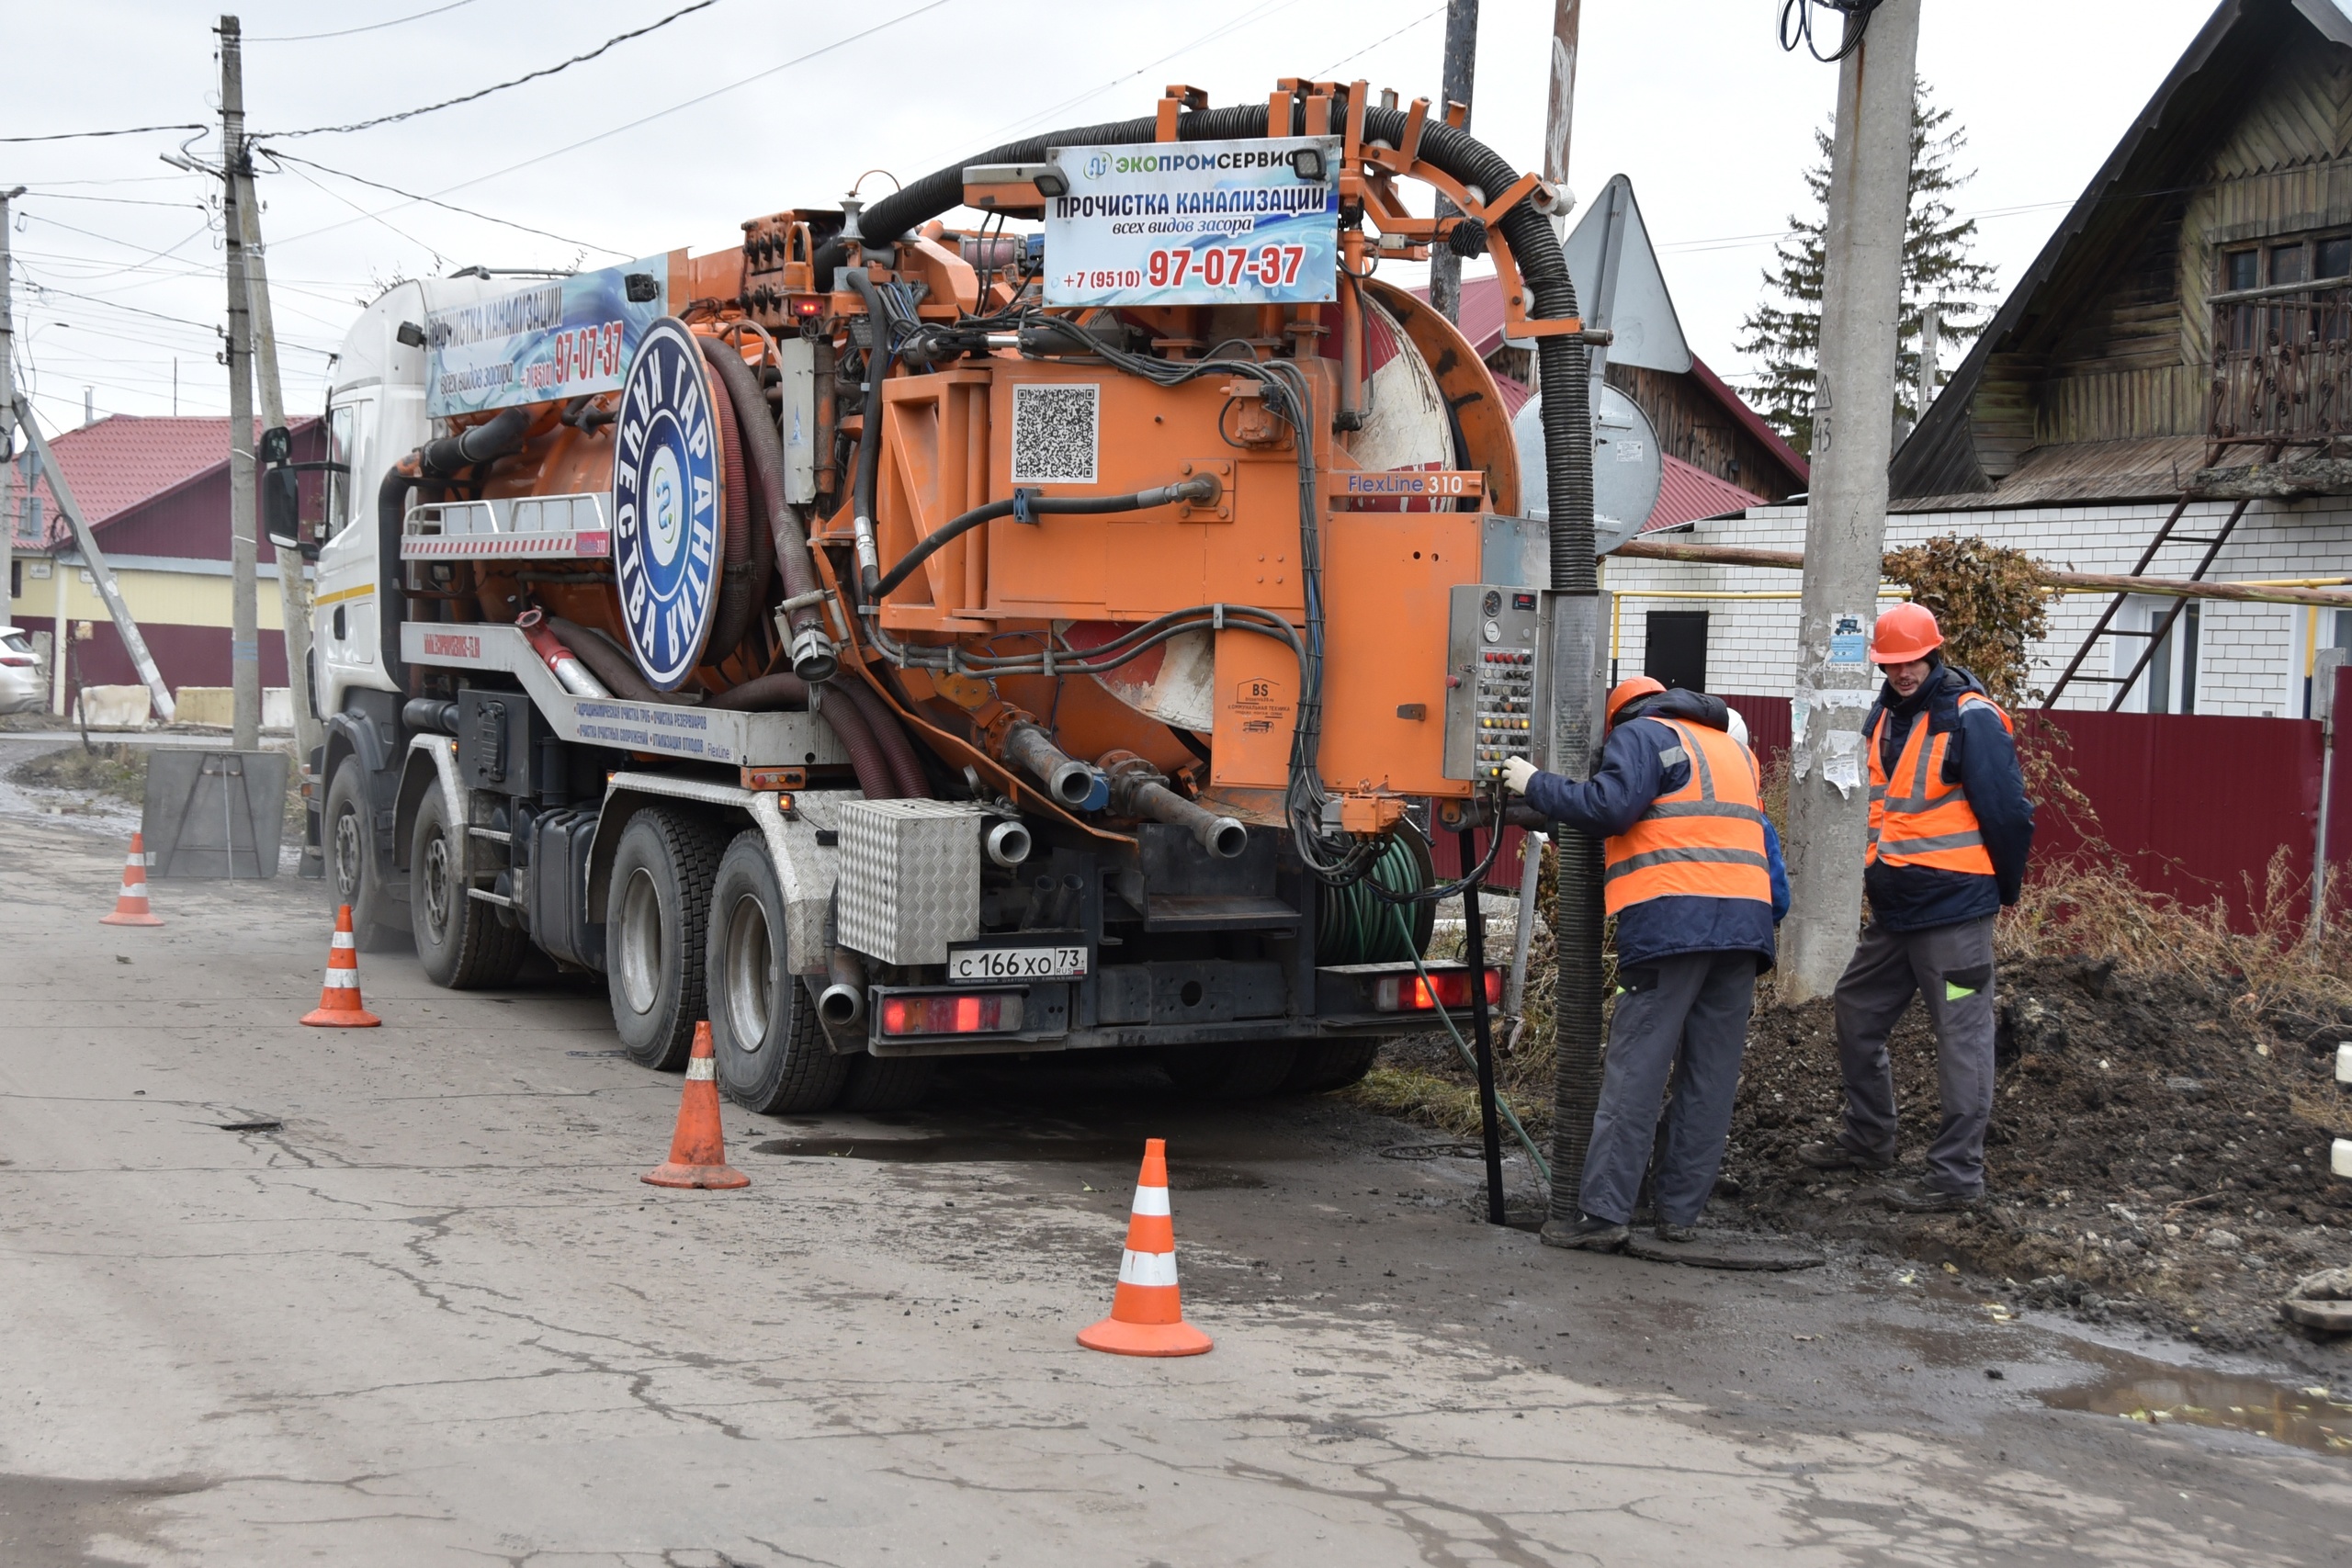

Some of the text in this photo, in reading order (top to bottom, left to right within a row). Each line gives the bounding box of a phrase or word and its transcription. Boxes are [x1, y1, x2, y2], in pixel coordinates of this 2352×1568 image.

[1057, 187, 1324, 219] ПРОЧИСТКА КАНАЛИЗАЦИИ
[1113, 217, 1252, 235] всех видов засора
[1064, 246, 1304, 288] +7 (9510) 97-07-37
[429, 286, 562, 353] ПРОЧИСТКА КАНАЛИЗАЦИИ
[555, 321, 624, 384] 97-07-37
[441, 363, 514, 395] всех видов засора
[1814, 417, 1832, 452] 43
[1349, 475, 1463, 494] FlexLine 310
[618, 347, 662, 660] КАЧЕСТВА
[666, 354, 712, 666] ГАРАНТИЯ
[1253, 683, 1268, 696] BS
[1058, 950, 1079, 967] 73
